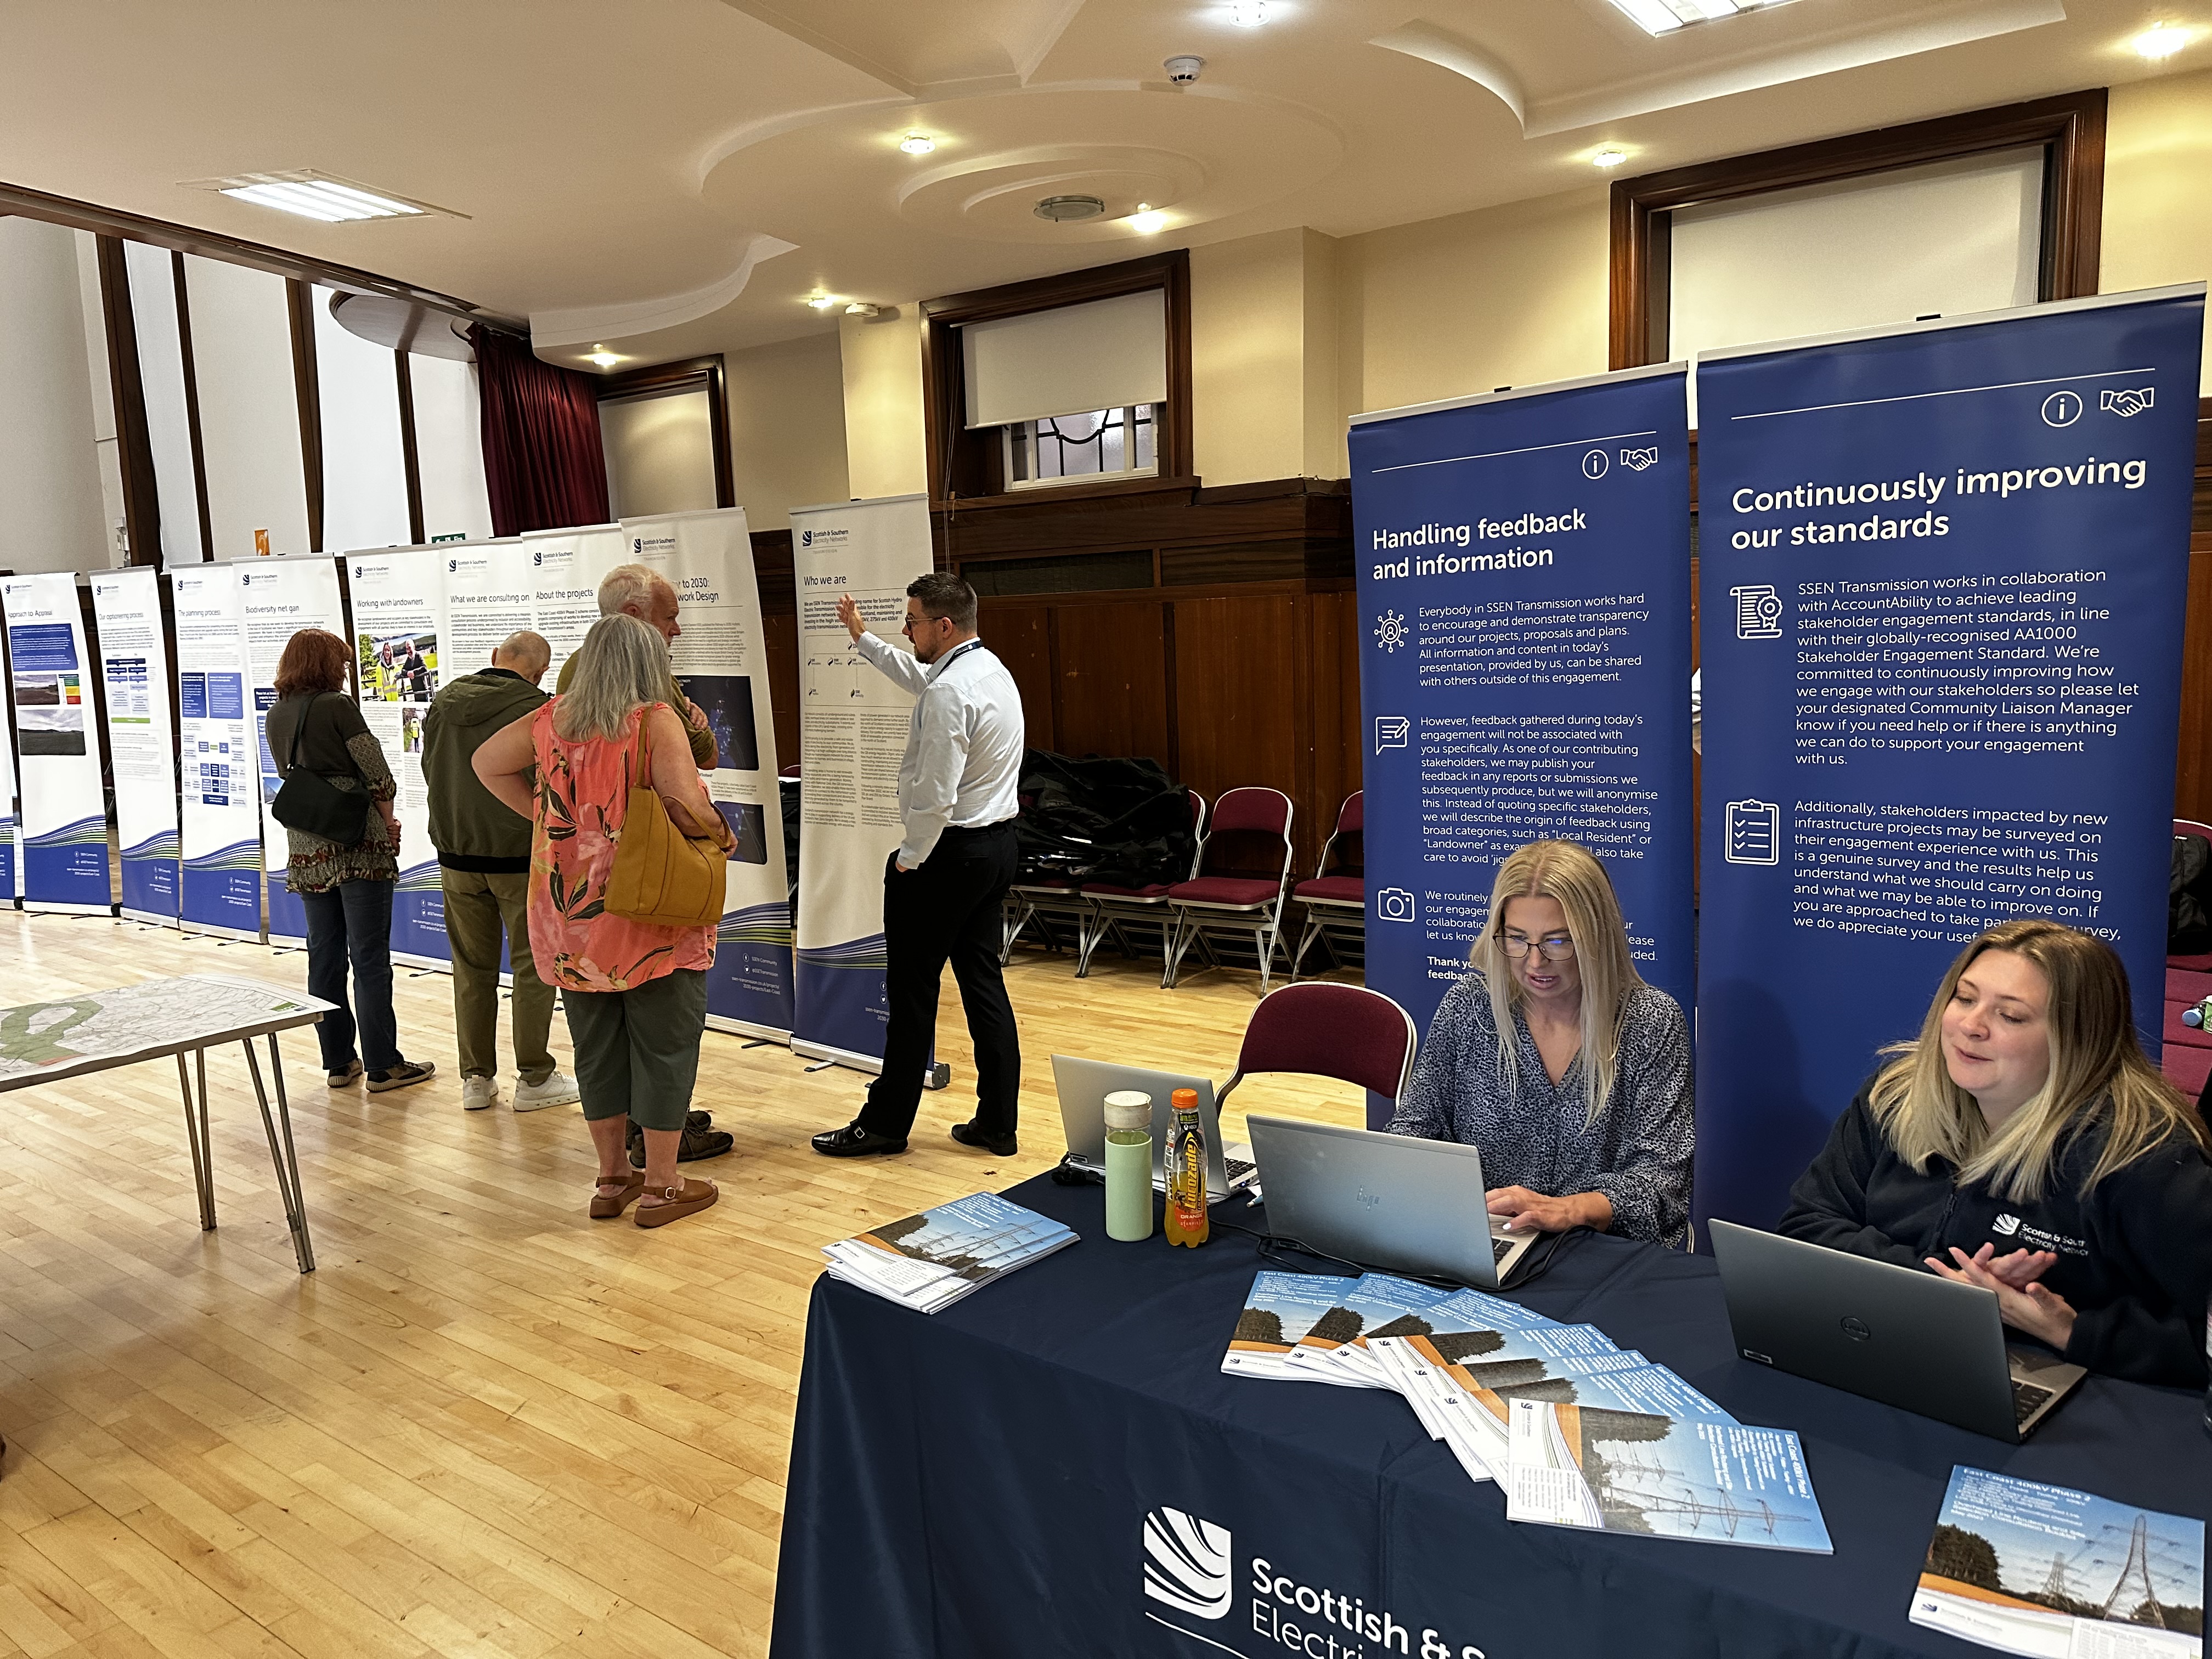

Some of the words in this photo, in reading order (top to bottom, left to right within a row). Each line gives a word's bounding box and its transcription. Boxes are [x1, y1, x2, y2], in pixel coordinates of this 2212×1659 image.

[1732, 472, 1946, 514] Continuously
[1956, 457, 2147, 498] improving
[1373, 523, 1470, 550] Handling
[1477, 507, 1587, 540] feedback
[1731, 528, 1783, 550] our
[1790, 510, 1949, 545] standards
[1373, 556, 1409, 580] and
[1416, 546, 1554, 577] information
[682, 579, 690, 588] to
[691, 577, 710, 588] 2030:
[804, 575, 819, 586] Who
[1798, 582, 1834, 595] SSEN
[1838, 578, 1928, 593] Transmission
[1932, 575, 1978, 589] works
[1982, 574, 1995, 586] in
[2000, 570, 2106, 586] collaboration
[357, 600, 379, 609] Working
[489, 594, 519, 603] consulting
[536, 591, 554, 600] About
[555, 590, 566, 598] the
[567, 588, 593, 600] projects
[678, 591, 695, 601] work
[696, 591, 719, 602] Design
[1798, 600, 1827, 612] with
[1831, 595, 1933, 611] AccountAbility
[1936, 595, 1952, 607] to
[1955, 592, 2015, 606] achieve
[2019, 589, 2076, 605] leading
[246, 606, 276, 614] Biodiversity
[1419, 604, 1472, 618] Everybody
[1474, 603, 1484, 614] in
[1486, 601, 1513, 613] SSEN
[1515, 599, 1582, 611] Transmission
[1584, 595, 1616, 607] works
[1619, 592, 1644, 605] hard
[1419, 622, 1430, 631] to
[1431, 619, 1488, 630] encourage
[1489, 616, 1509, 627] and
[1511, 613, 1576, 626] demonstrate
[1578, 611, 1650, 623] transparency
[1797, 615, 1880, 629] stakeholder
[1882, 612, 1974, 629] engagement
[1977, 608, 2055, 623] standards,
[2061, 610, 2075, 620] in
[2080, 607, 2110, 620] line
[1419, 634, 1455, 645] around
[1457, 635, 1476, 643] our
[1479, 631, 1521, 645] projects,
[1523, 628, 1573, 642] proposals
[1576, 626, 1595, 637] and
[1598, 625, 1630, 639] plans.
[1419, 649, 1432, 659] All
[1434, 646, 1494, 658] information
[1496, 645, 1515, 656] and
[1517, 644, 1558, 654] content
[1560, 645, 1570, 653] in
[1572, 641, 1609, 654] today’s
[1419, 661, 1486, 675] presentation,
[1488, 659, 1532, 673] provided
[1534, 658, 1547, 671] by
[1549, 660, 1564, 669] us,
[1566, 659, 1586, 668] can
[1588, 656, 1602, 667] be
[1604, 654, 1642, 667] shared
[1419, 676, 1441, 686] with
[1443, 675, 1477, 686] others
[1479, 674, 1517, 685] outside
[1519, 673, 1530, 684] of
[1531, 673, 1550, 683] this
[1552, 672, 1622, 685] engagement.
[1794, 800, 1876, 817] Additionally,
[1880, 804, 1968, 819] stakeholders
[1973, 807, 2044, 823] impacted
[2049, 810, 2068, 827] by
[2073, 814, 2108, 825] new
[1795, 816, 1884, 832] infrastructure
[1887, 822, 1943, 837] projects
[1946, 827, 1978, 840] may
[1982, 826, 2001, 838] be
[2005, 830, 2075, 844] surveyed
[2079, 833, 2101, 844] on
[1184, 1143, 1198, 1210] Lucozade
[2018, 1231, 2057, 1251] Electricity
[2021, 1223, 2052, 1240] Scottish
[2053, 1234, 2061, 1242] &
[1402, 1279, 1423, 1289] 400kV
[1423, 1285, 1443, 1295] Phase
[1657, 1366, 1668, 1375] East
[1667, 1374, 1684, 1386] Coast
[1699, 1397, 1715, 1410] Phase
[1964, 1468, 1983, 1477] East
[1985, 1473, 2013, 1485] Coast
[2051, 1488, 2082, 1499] Phase
[1252, 1557, 1409, 1655] Scottish
[1420, 1628, 1451, 1659] &
